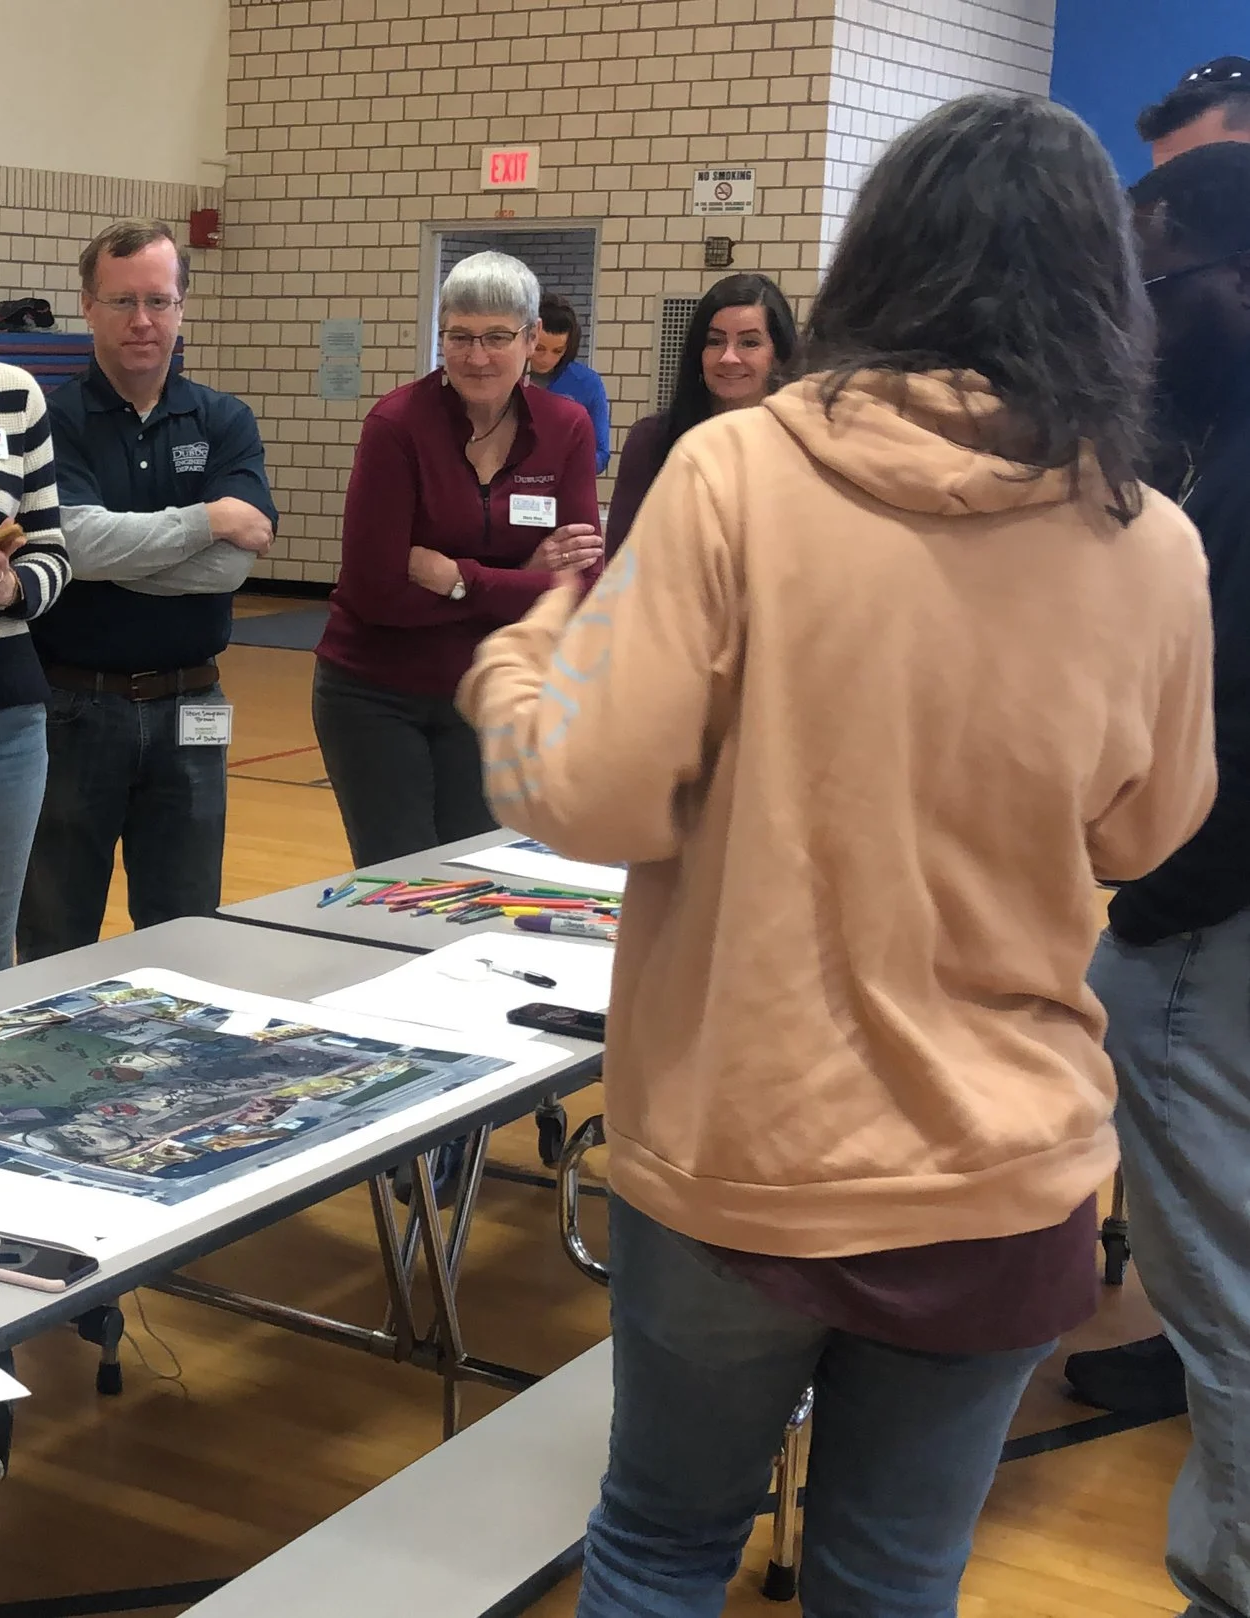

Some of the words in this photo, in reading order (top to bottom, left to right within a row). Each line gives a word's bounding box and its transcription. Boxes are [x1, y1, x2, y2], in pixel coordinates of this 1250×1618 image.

[490, 152, 529, 183] EXIT
[697, 171, 710, 181] NO
[712, 170, 752, 181] SMOKING
